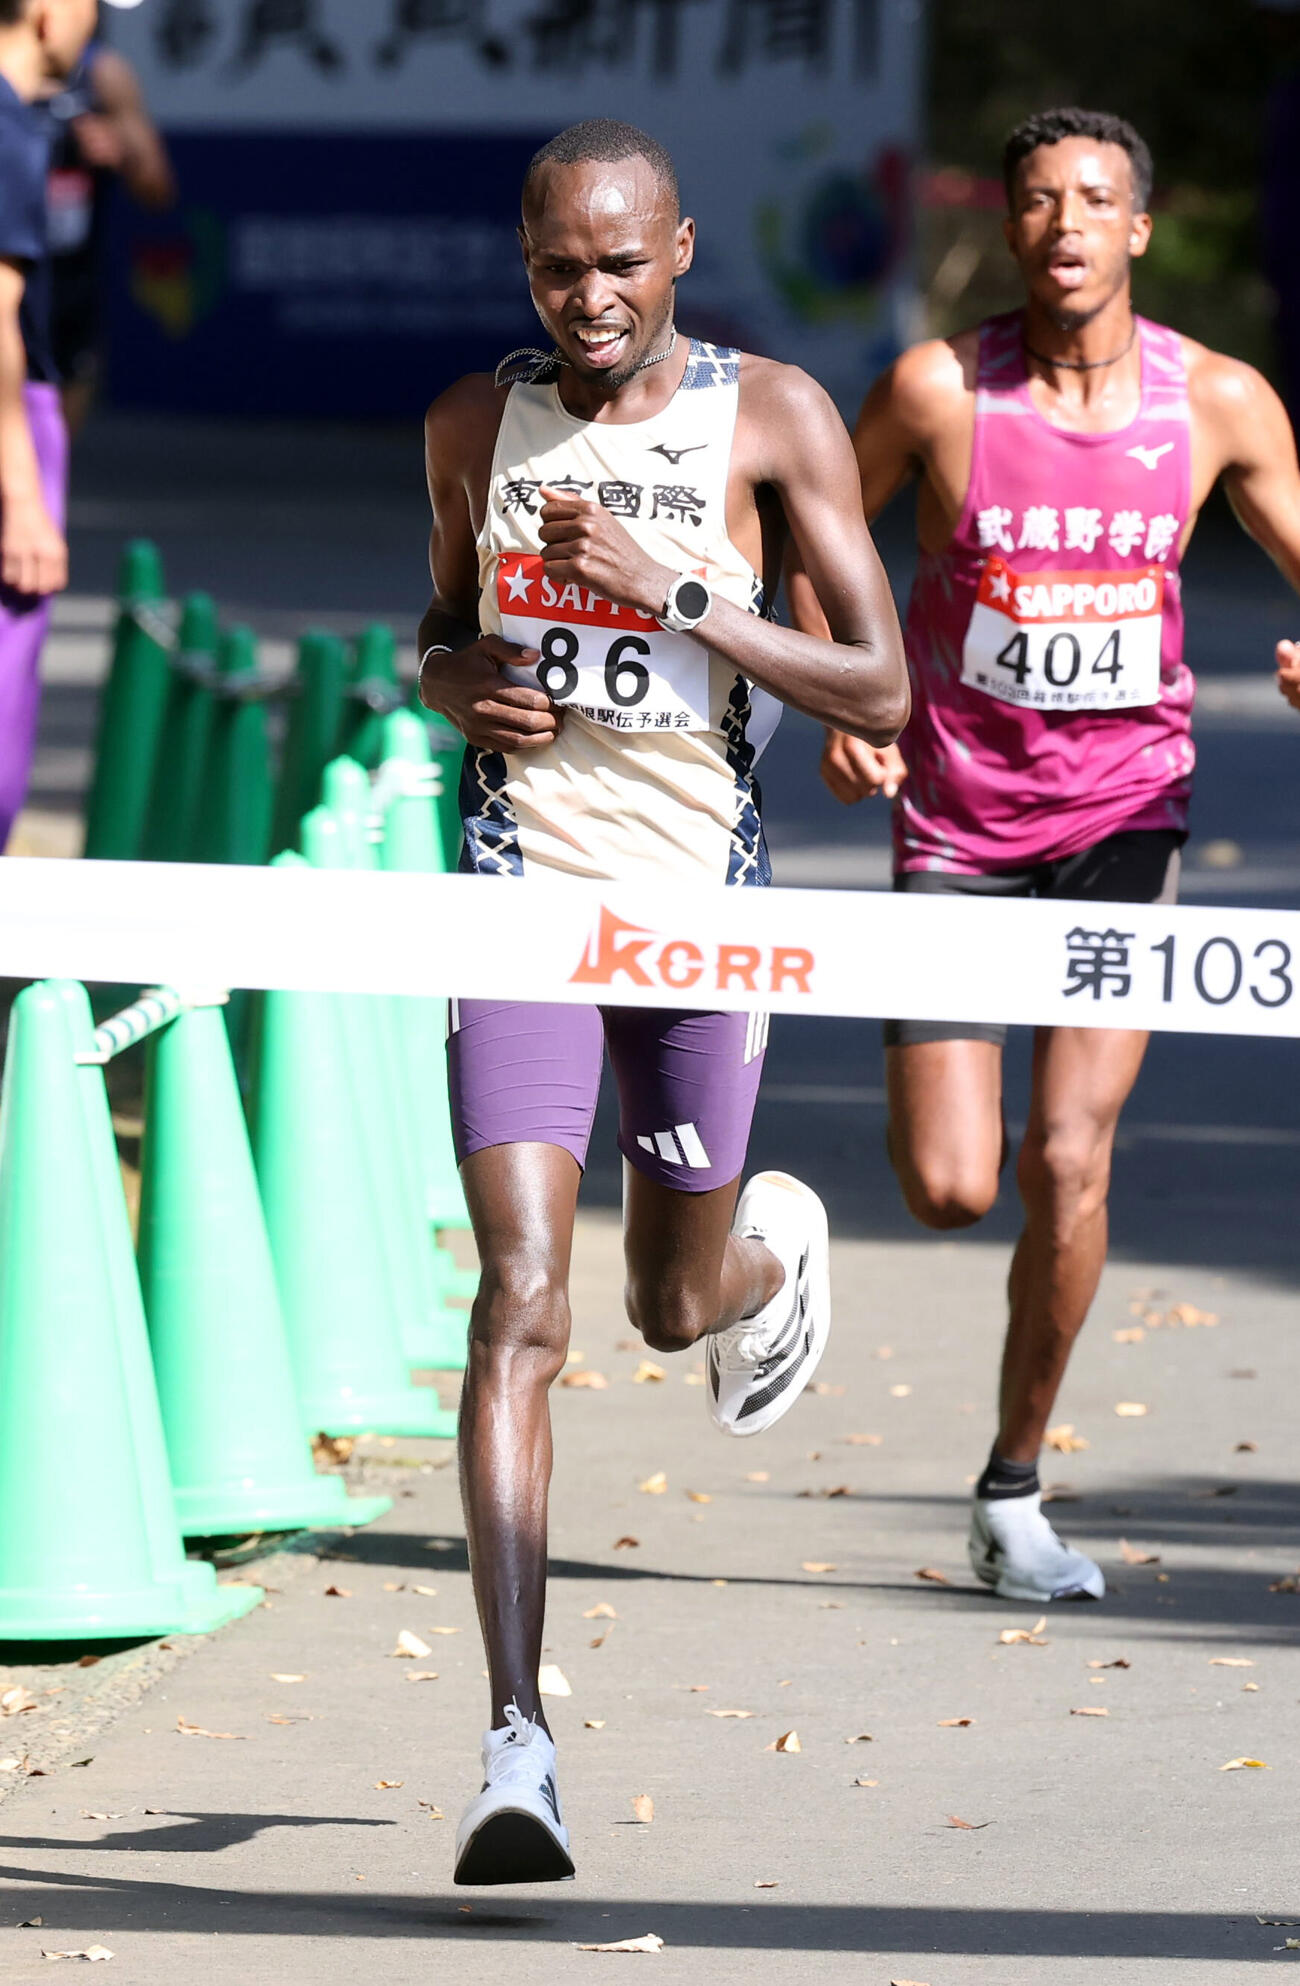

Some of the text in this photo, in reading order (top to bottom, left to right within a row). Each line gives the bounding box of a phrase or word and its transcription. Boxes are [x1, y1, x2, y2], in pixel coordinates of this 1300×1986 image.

[977, 505, 1179, 562] 武蔵野学院
[540, 574, 653, 619] SAP
[1014, 578, 1157, 617] SAPPORO
[536, 627, 651, 706] 86
[996, 629, 1124, 686] 404
[562, 702, 691, 728] 根駅伝予選会
[567, 901, 815, 994] KCRR
[1062, 926, 1293, 1008] 第103
